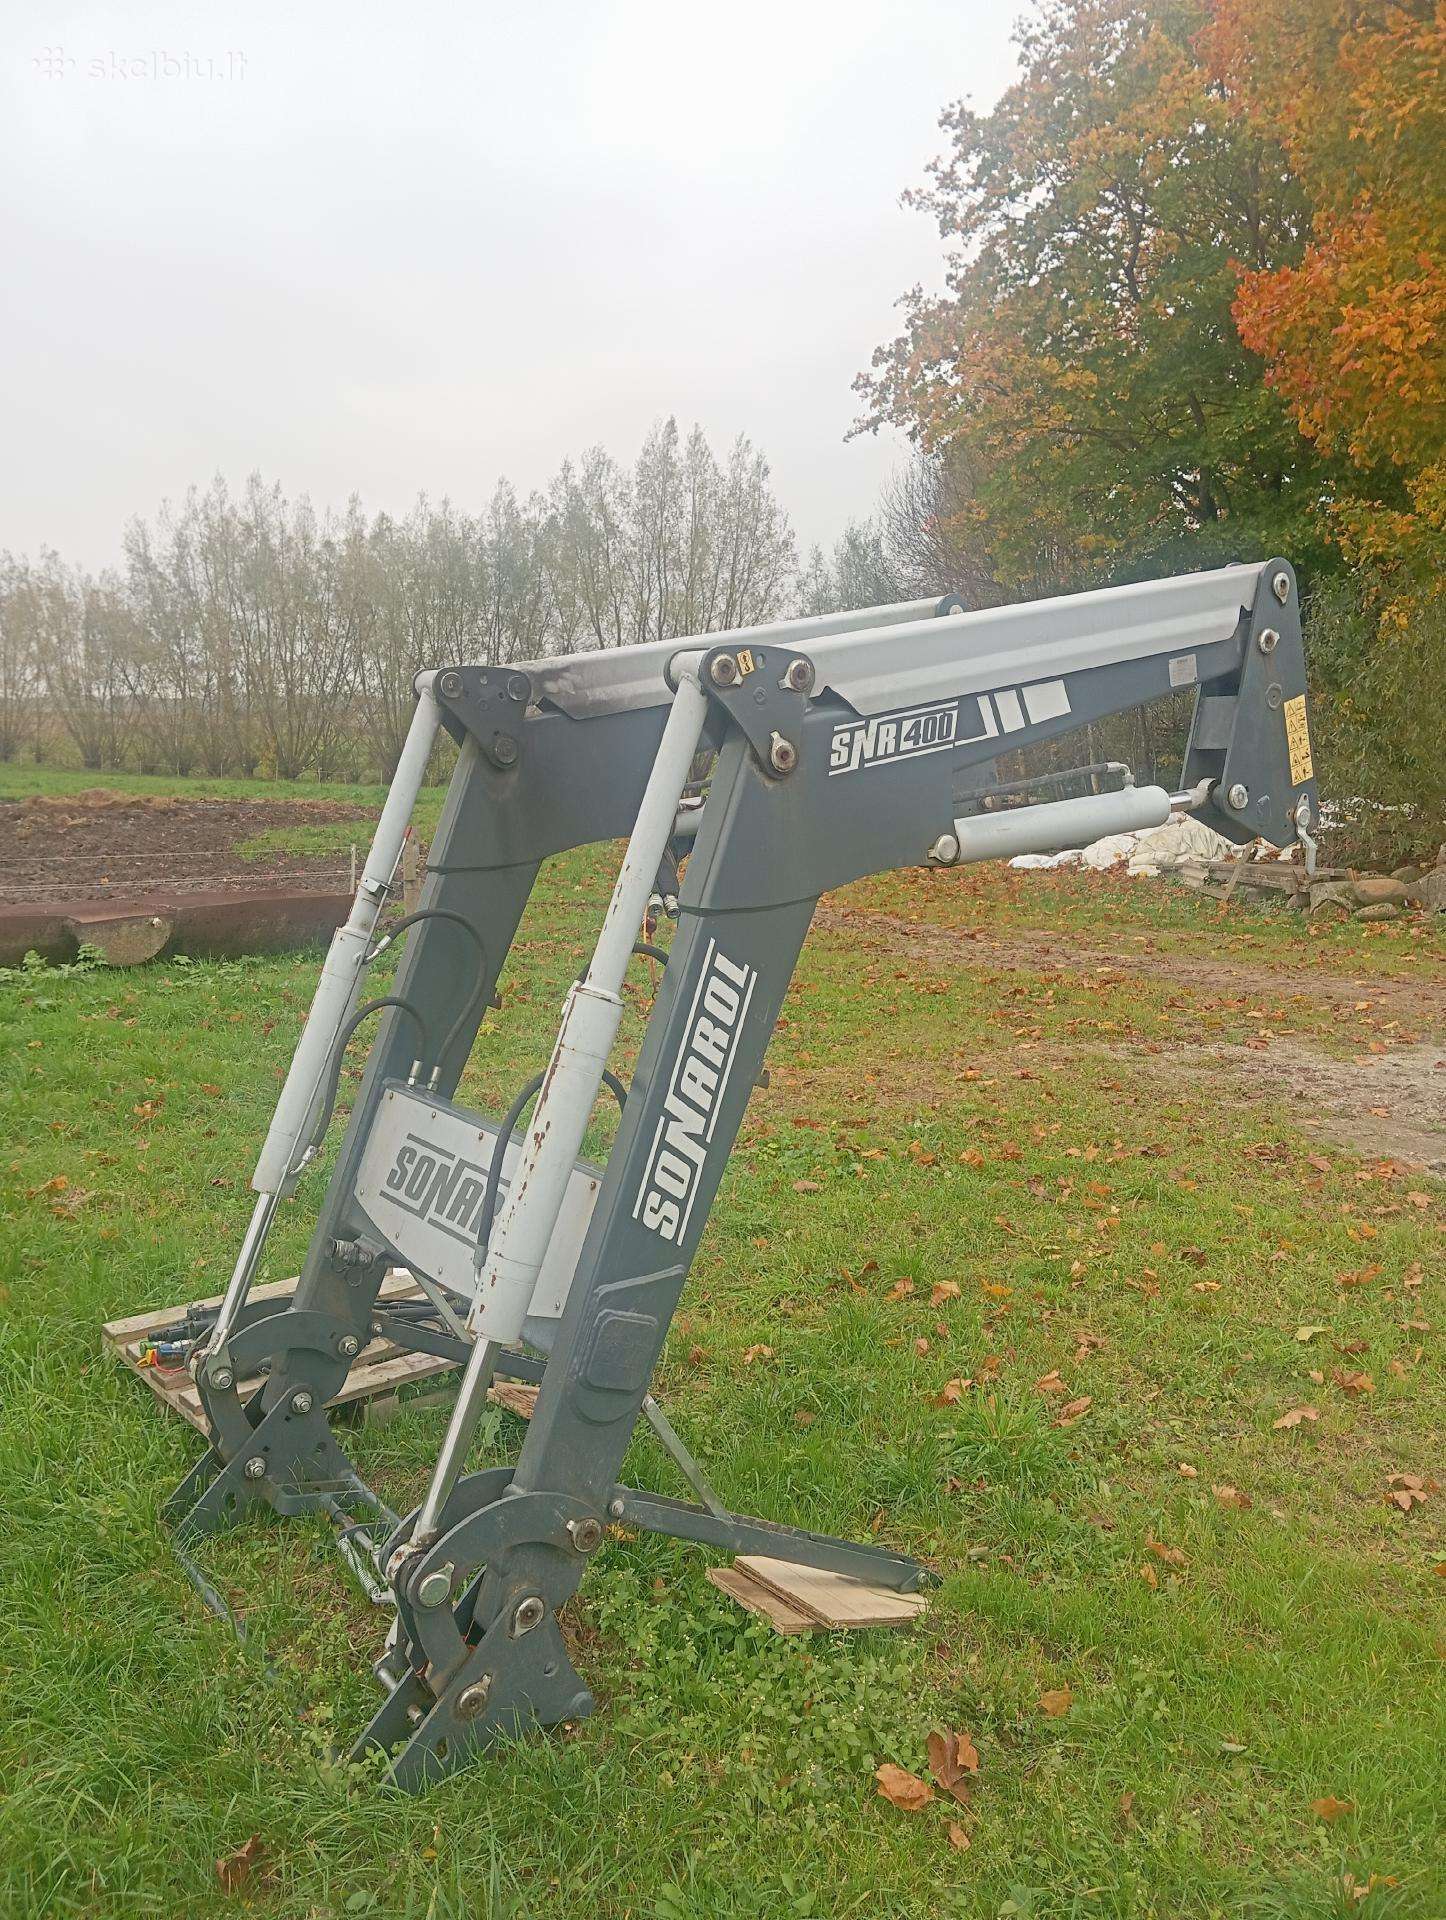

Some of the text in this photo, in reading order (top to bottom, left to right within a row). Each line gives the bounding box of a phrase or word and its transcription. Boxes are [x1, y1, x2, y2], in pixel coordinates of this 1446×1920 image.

[830, 711, 955, 769] SNR 400
[643, 952, 750, 1240] SONAROL
